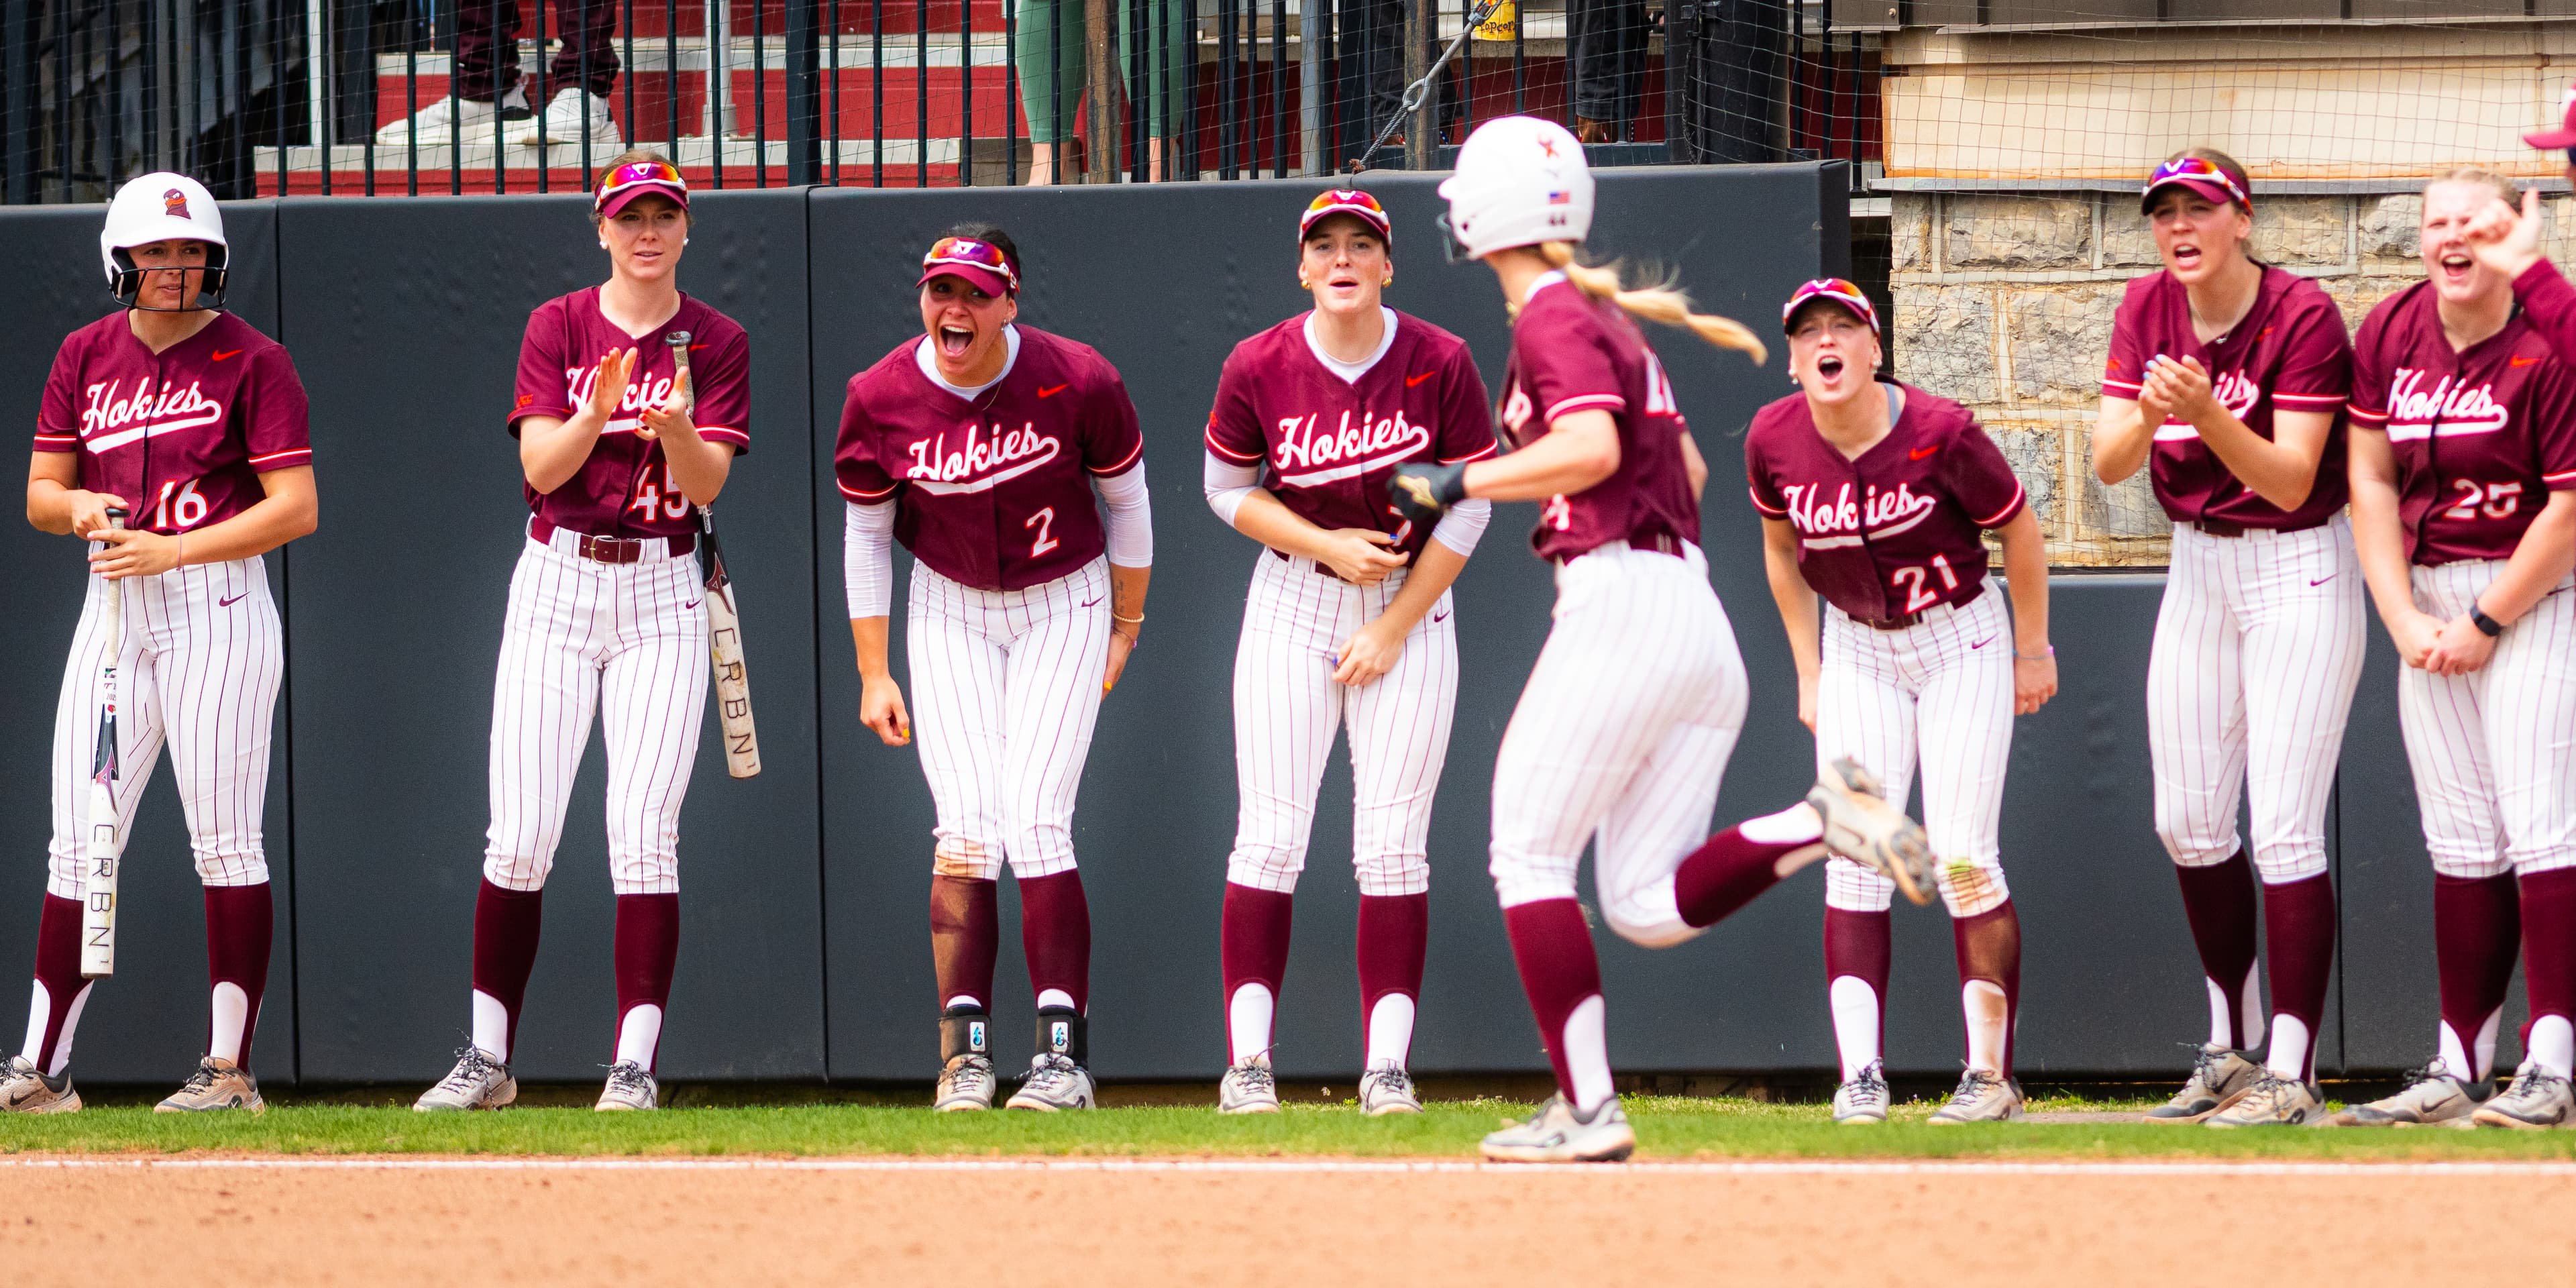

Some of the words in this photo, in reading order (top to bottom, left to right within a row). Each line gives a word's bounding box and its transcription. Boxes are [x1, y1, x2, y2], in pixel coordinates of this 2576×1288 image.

[1481, 20, 1515, 34] opcor
[79, 376, 222, 443] Hokies
[2385, 367, 2509, 431] Hokies
[906, 422, 1060, 486] Hokies
[1275, 409, 1430, 475] Hokies
[154, 478, 210, 529] 16
[628, 464, 690, 523] 45
[1782, 480, 1937, 539] Hokies
[2443, 478, 2524, 521] 25
[1024, 505, 1060, 559] 2
[1892, 552, 1960, 614] 21
